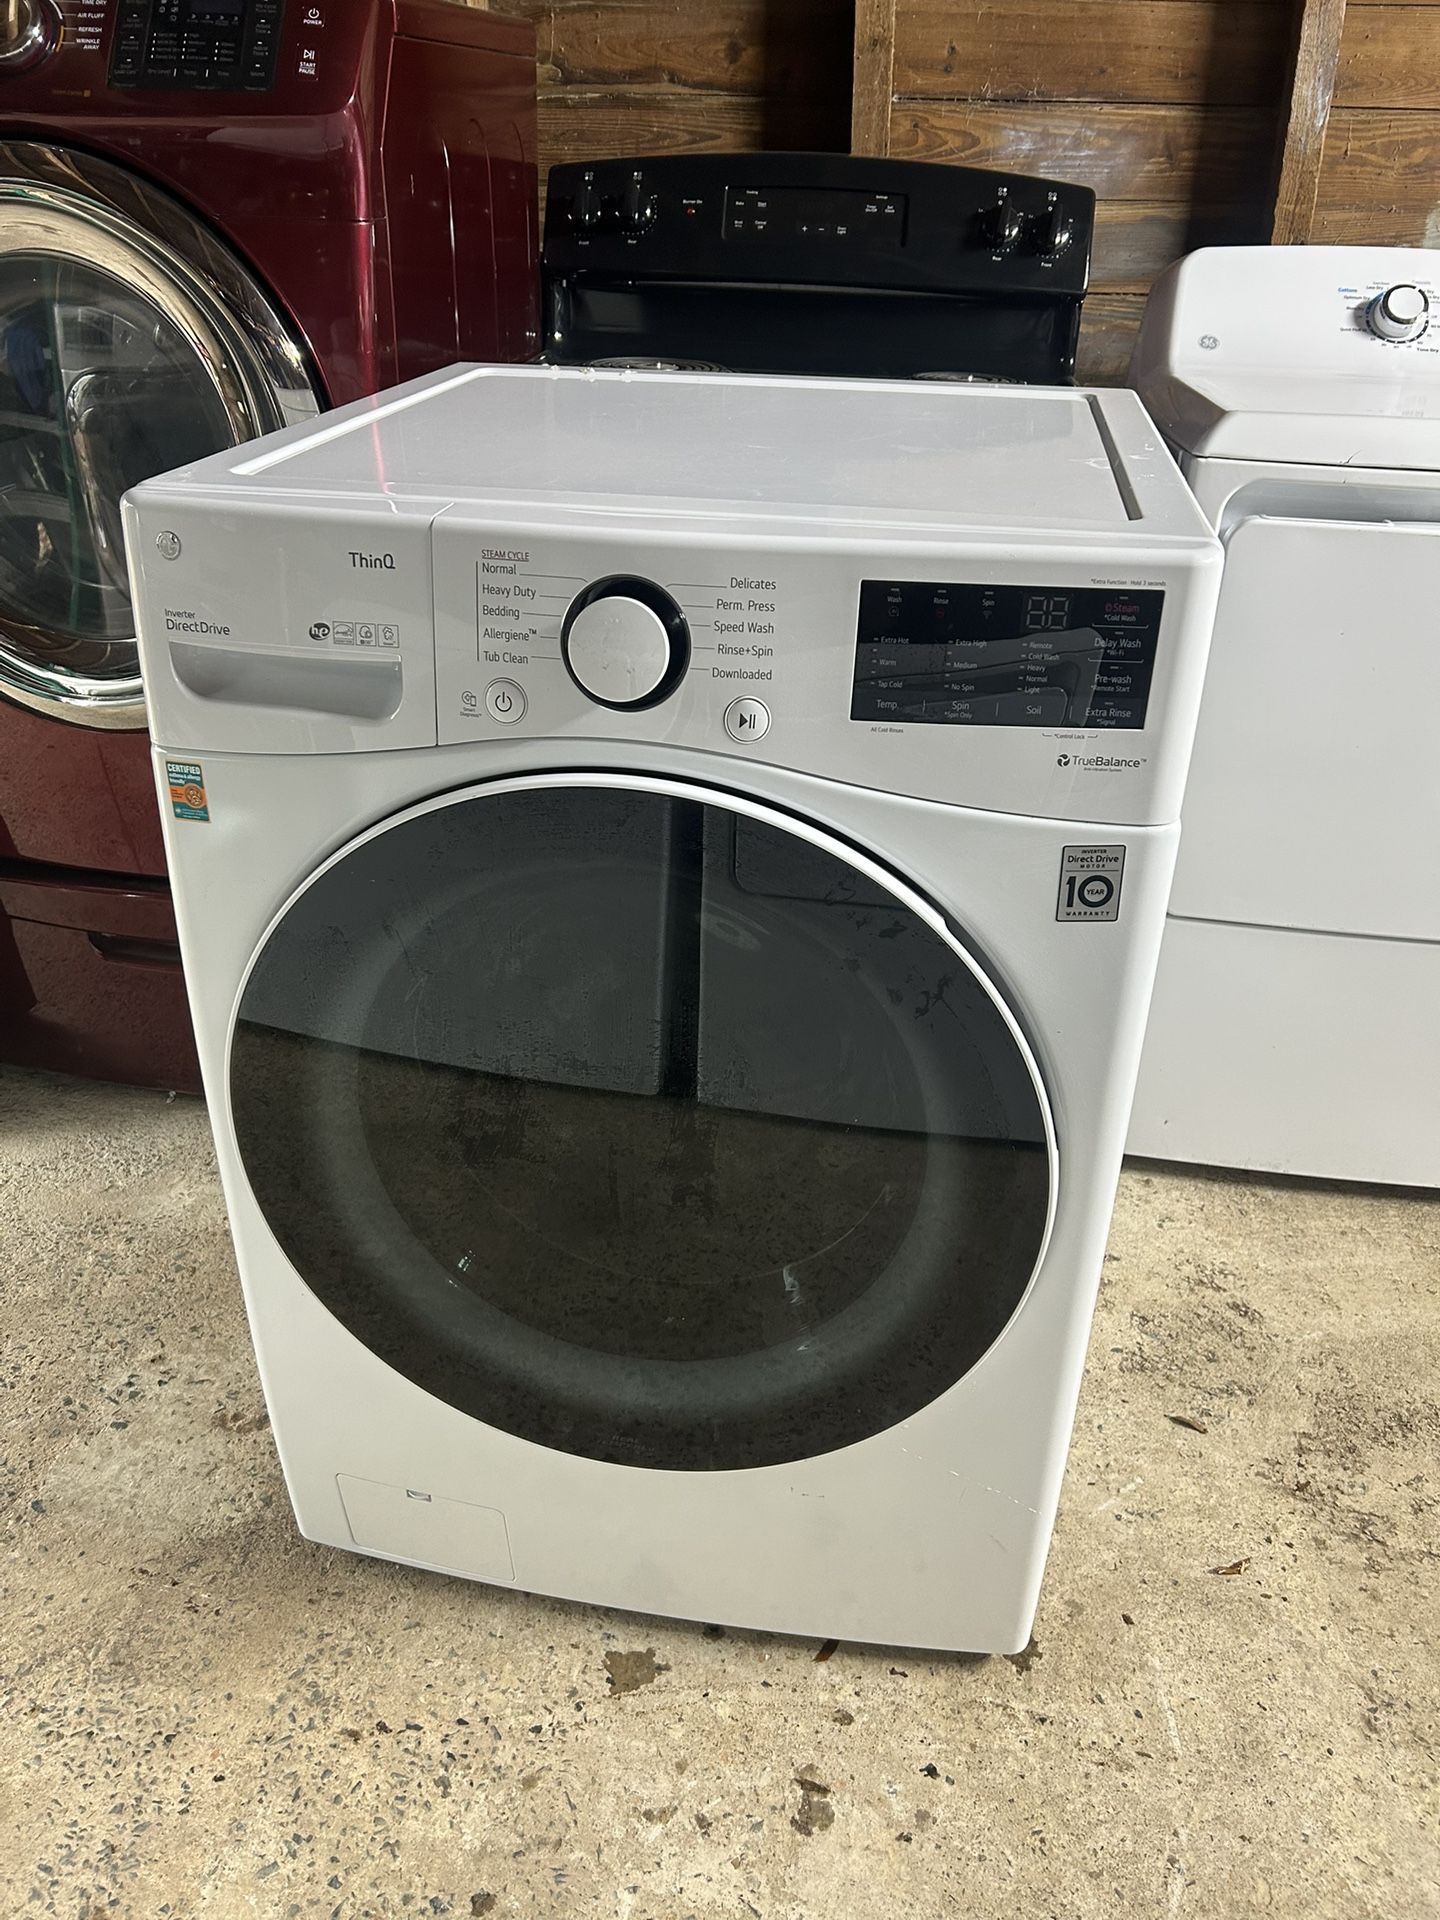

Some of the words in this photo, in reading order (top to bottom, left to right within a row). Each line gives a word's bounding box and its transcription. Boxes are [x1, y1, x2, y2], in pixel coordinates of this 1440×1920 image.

[481, 548, 506, 560] STEAM
[507, 550, 530, 561] CYCLE
[348, 552, 396, 570] ThinQ
[482, 562, 517, 575] Normal
[730, 577, 777, 590] Delicates
[482, 584, 511, 598] Heavy
[513, 585, 538, 601] Duty
[887, 595, 903, 603] Wash
[982, 598, 995, 608] Spin
[716, 598, 744, 611] Perm.
[748, 599, 776, 612] Press
[1114, 602, 1140, 613] Steam
[164, 607, 196, 619] Inverter
[482, 604, 520, 620] Bedding
[713, 619, 744, 635] Speed
[747, 622, 774, 634] Wash
[880, 636, 897, 644] Extra
[898, 637, 910, 645] Hot
[955, 639, 971, 647] Extra
[972, 640, 988, 649] High
[1029, 641, 1053, 650] Remote
[1094, 637, 1117, 649] Delay
[1119, 638, 1142, 648] Wash
[717, 643, 774, 659] Rinse+Spin
[483, 650, 501, 662] Tub
[502, 652, 530, 664] Clean
[879, 657, 896, 666] Warm
[1028, 653, 1043, 662] Cold
[1044, 654, 1060, 662] Wash
[953, 661, 978, 670] Medium
[1027, 664, 1046, 673] Heavy
[712, 666, 773, 681] Downloaded
[1025, 675, 1048, 683] Normal
[1095, 673, 1132, 684] Pre-wash
[878, 680, 889, 690] Tap
[889, 681, 903, 690] Cold
[951, 682, 960, 691] No
[961, 683, 975, 694] Spin
[1024, 686, 1040, 695] Light
[1115, 685, 1131, 693] Start
[952, 701, 970, 712] Spin
[1026, 705, 1042, 715] Soil
[960, 711, 974, 721] Only
[1085, 707, 1107, 717] Extra
[1109, 708, 1132, 718] Rinse
[167, 763, 201, 775] CERTIFIED
[1067, 855, 1094, 863] Direct
[1095, 855, 1119, 863] Drive
[1066, 875, 1114, 908] 10
